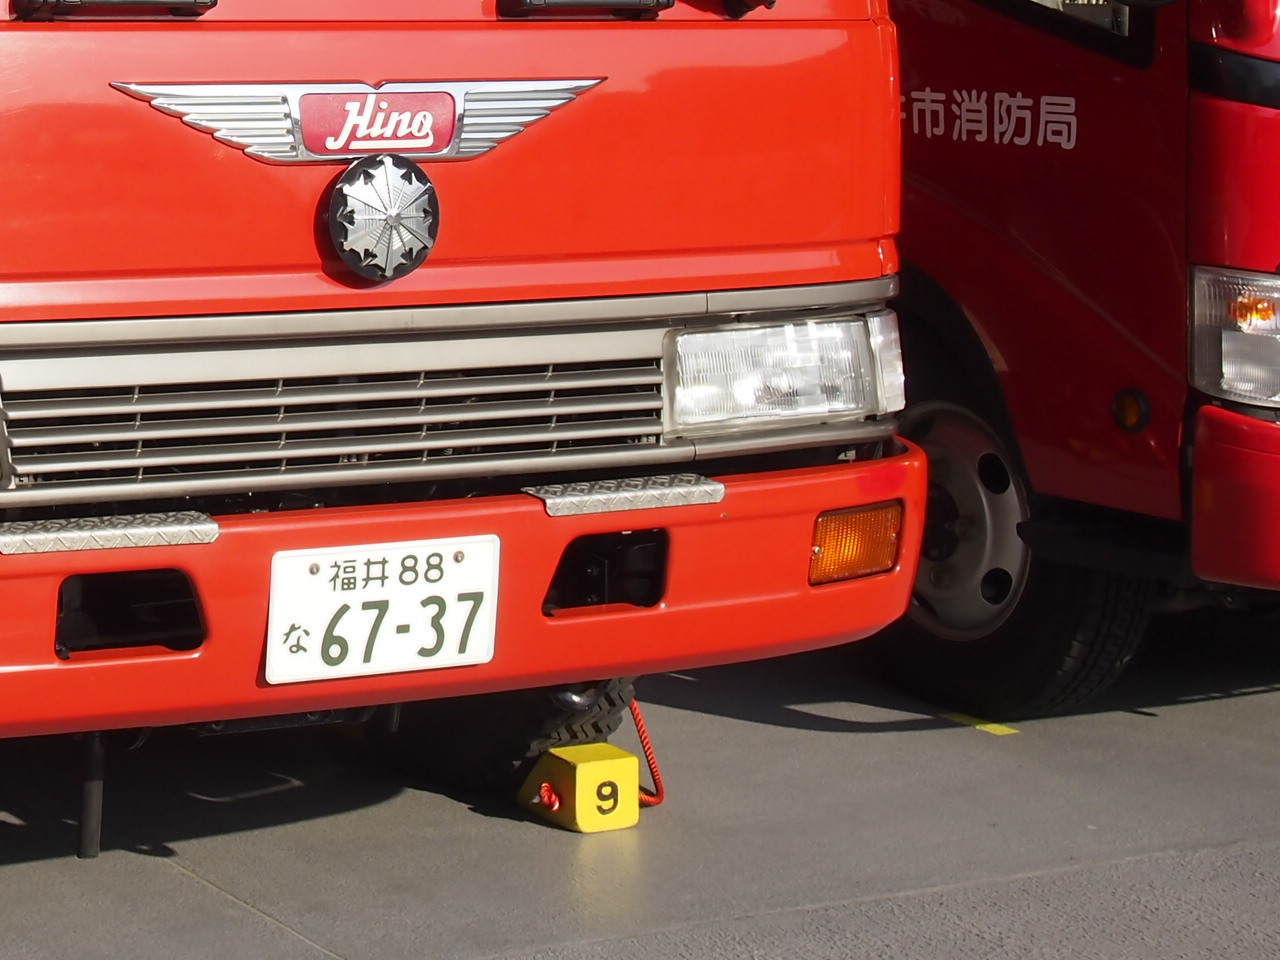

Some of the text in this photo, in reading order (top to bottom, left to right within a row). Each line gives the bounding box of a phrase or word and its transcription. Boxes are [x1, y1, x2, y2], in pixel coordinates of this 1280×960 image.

[324, 92, 434, 151] Hino
[900, 85, 1078, 151] 市消防局
[282, 622, 311, 655] な
[320, 591, 484, 667] 67-37
[596, 780, 619, 816] 9
